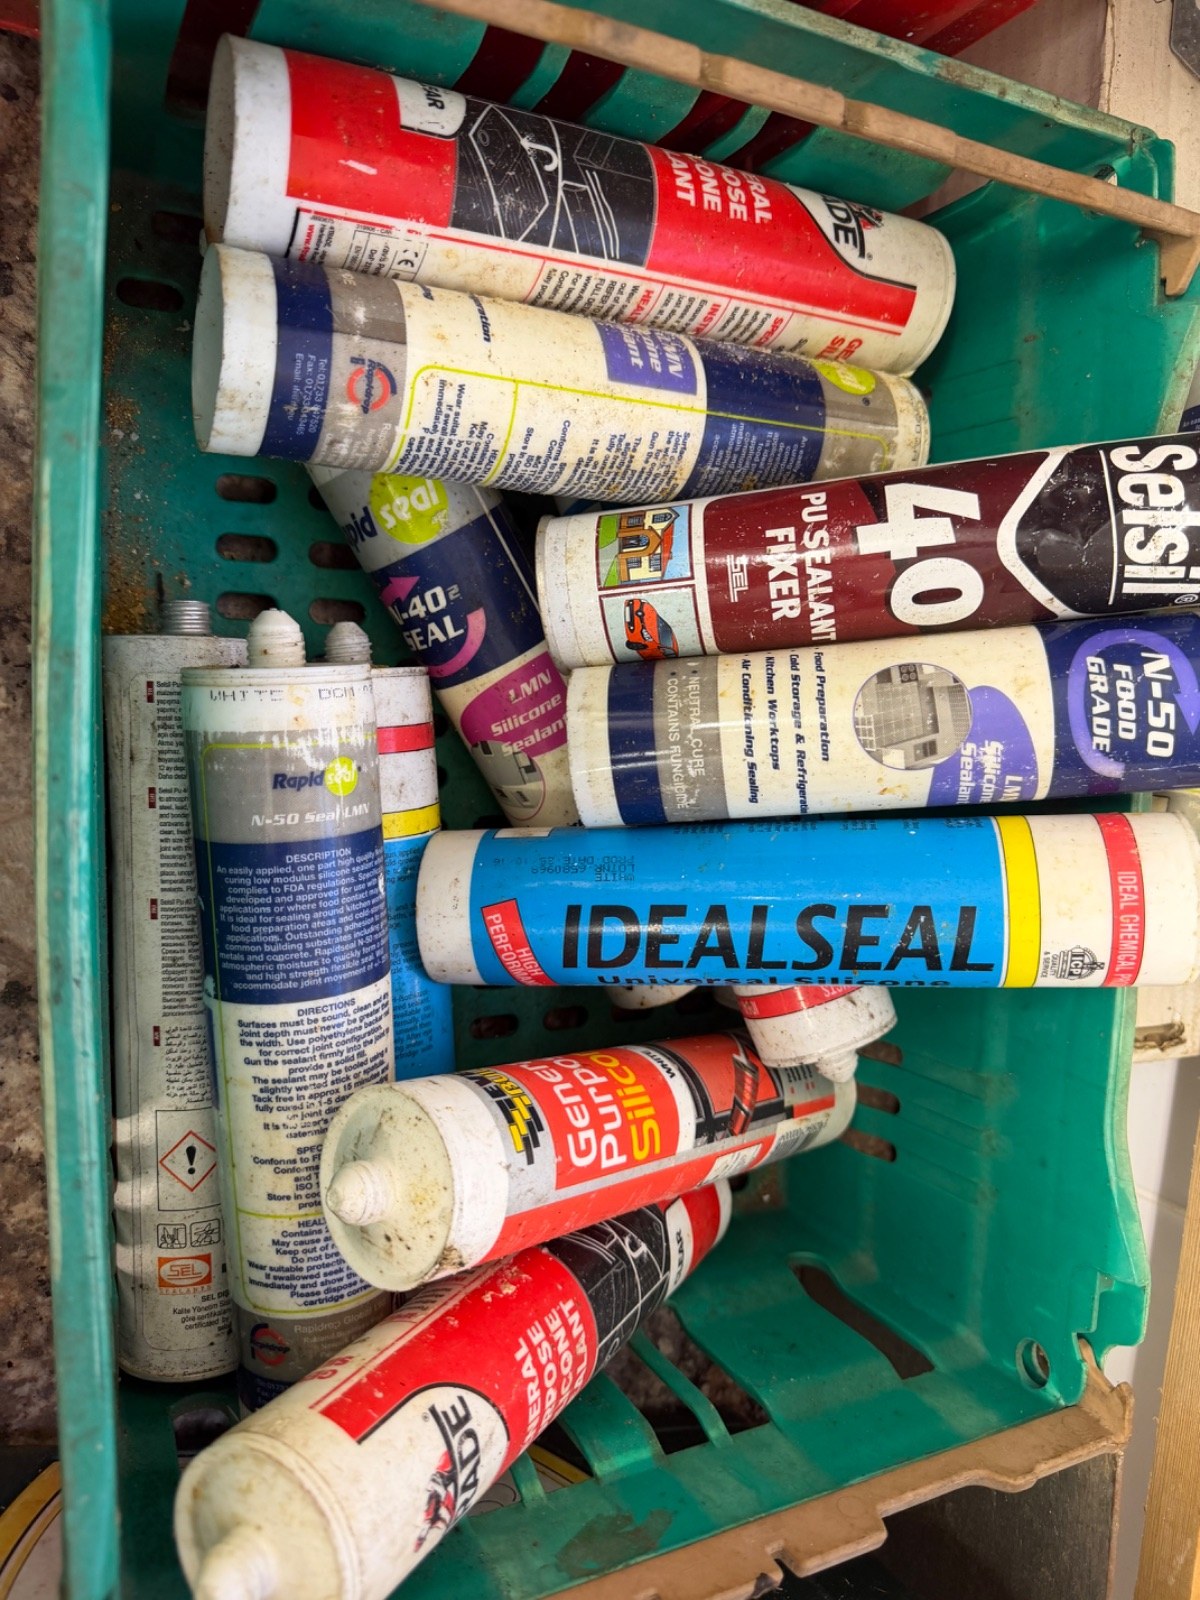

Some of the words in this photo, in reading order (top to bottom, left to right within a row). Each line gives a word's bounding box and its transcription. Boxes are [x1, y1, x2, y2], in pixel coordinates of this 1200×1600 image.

[569, 273, 582, 286] For
[591, 278, 606, 296] FULL
[292, 352, 303, 382] Email:
[361, 359, 375, 413] Rapidrop
[455, 383, 465, 409] Wear
[475, 421, 487, 440] May
[799, 491, 828, 523] PU
[854, 482, 984, 626] 40
[764, 526, 801, 621] FIXER
[802, 528, 836, 641] SEALANT
[741, 659, 751, 669] Air
[789, 654, 799, 670] Cold
[814, 651, 824, 672] Food
[764, 656, 775, 694] Kitchen
[508, 668, 552, 704] LMN
[687, 676, 701, 732] NEUTRAL
[790, 673, 801, 728] Storage
[1085, 656, 1110, 752] GRADE
[1112, 663, 1136, 740] FOOD
[1140, 651, 1175, 757] N-50
[490, 693, 561, 736] Silicone
[667, 679, 679, 741] CONTAINS
[741, 673, 754, 757] Conditioning
[815, 675, 830, 761] Preparation
[767, 699, 780, 770] Worktops
[795, 733, 804, 744] &
[690, 738, 705, 776] CURE
[670, 745, 688, 809] FUNGICIDE
[746, 761, 758, 803] Sealing
[956, 742, 976, 804] Sealant
[250, 811, 299, 827] N-50
[343, 801, 371, 821] LMN
[285, 847, 351, 863] DESCRIPTION
[255, 865, 294, 875] applied,
[297, 863, 315, 871] one
[224, 877, 251, 886] curing
[253, 876, 271, 884] low
[272, 872, 316, 883] modulus
[225, 894, 272, 905] developed
[274, 894, 293, 903] and
[295, 888, 339, 903] approved
[227, 885, 268, 896] complies
[270, 885, 281, 893] to
[283, 883, 304, 892] FDA
[1117, 871, 1139, 909] IDEAL
[286, 902, 317, 912] where
[318, 898, 339, 907] food
[235, 914, 257, 922] ideal
[275, 912, 310, 924] sealing
[312, 906, 345, 918] around
[231, 924, 250, 933] food
[252, 922, 308, 934] preparation
[285, 924, 342, 941] Outstanding
[562, 903, 996, 971] IDEALSEAL
[224, 943, 261, 952] common
[263, 940, 303, 952] building
[1114, 914, 1139, 971] CHEMICAL
[219, 952, 244, 961] metals
[246, 952, 263, 961] and
[276, 958, 319, 969] moisture
[515, 947, 544, 976] HIGH
[1069, 956, 1083, 974] ICP
[232, 979, 298, 989] accommodate
[297, 998, 355, 1017] DIRECTIONS
[237, 1019, 276, 1028] Surfaces
[279, 1018, 304, 1027] must
[239, 1029, 261, 1038] Joint
[262, 1028, 290, 1038] depth
[292, 1026, 317, 1035] must
[319, 1022, 345, 1031] never
[286, 1037, 305, 1046] Use
[243, 1057, 261, 1065] Gun
[263, 1057, 279, 1065] the
[281, 1053, 316, 1064] sealant
[259, 1049, 272, 1057] for
[274, 1047, 309, 1056] correct
[251, 1075, 269, 1084] The
[271, 1074, 306, 1084] sealant
[308, 1072, 328, 1081] may
[331, 1067, 342, 1076] be
[288, 1063, 324, 1075] provide
[251, 1094, 272, 1103] Tack
[275, 1093, 293, 1102] free
[259, 1084, 292, 1094] slightly
[281, 1227, 323, 1238] Contains
[271, 1238, 290, 1248] May
[292, 1237, 320, 1245] cause
[167, 1263, 202, 1276] SEL
[272, 1271, 320, 1280] swallowed
[300, 1280, 317, 1288] and
[201, 1294, 215, 1302] SEL
[290, 1289, 321, 1298] Please
[302, 1293, 344, 1306] cartridge
